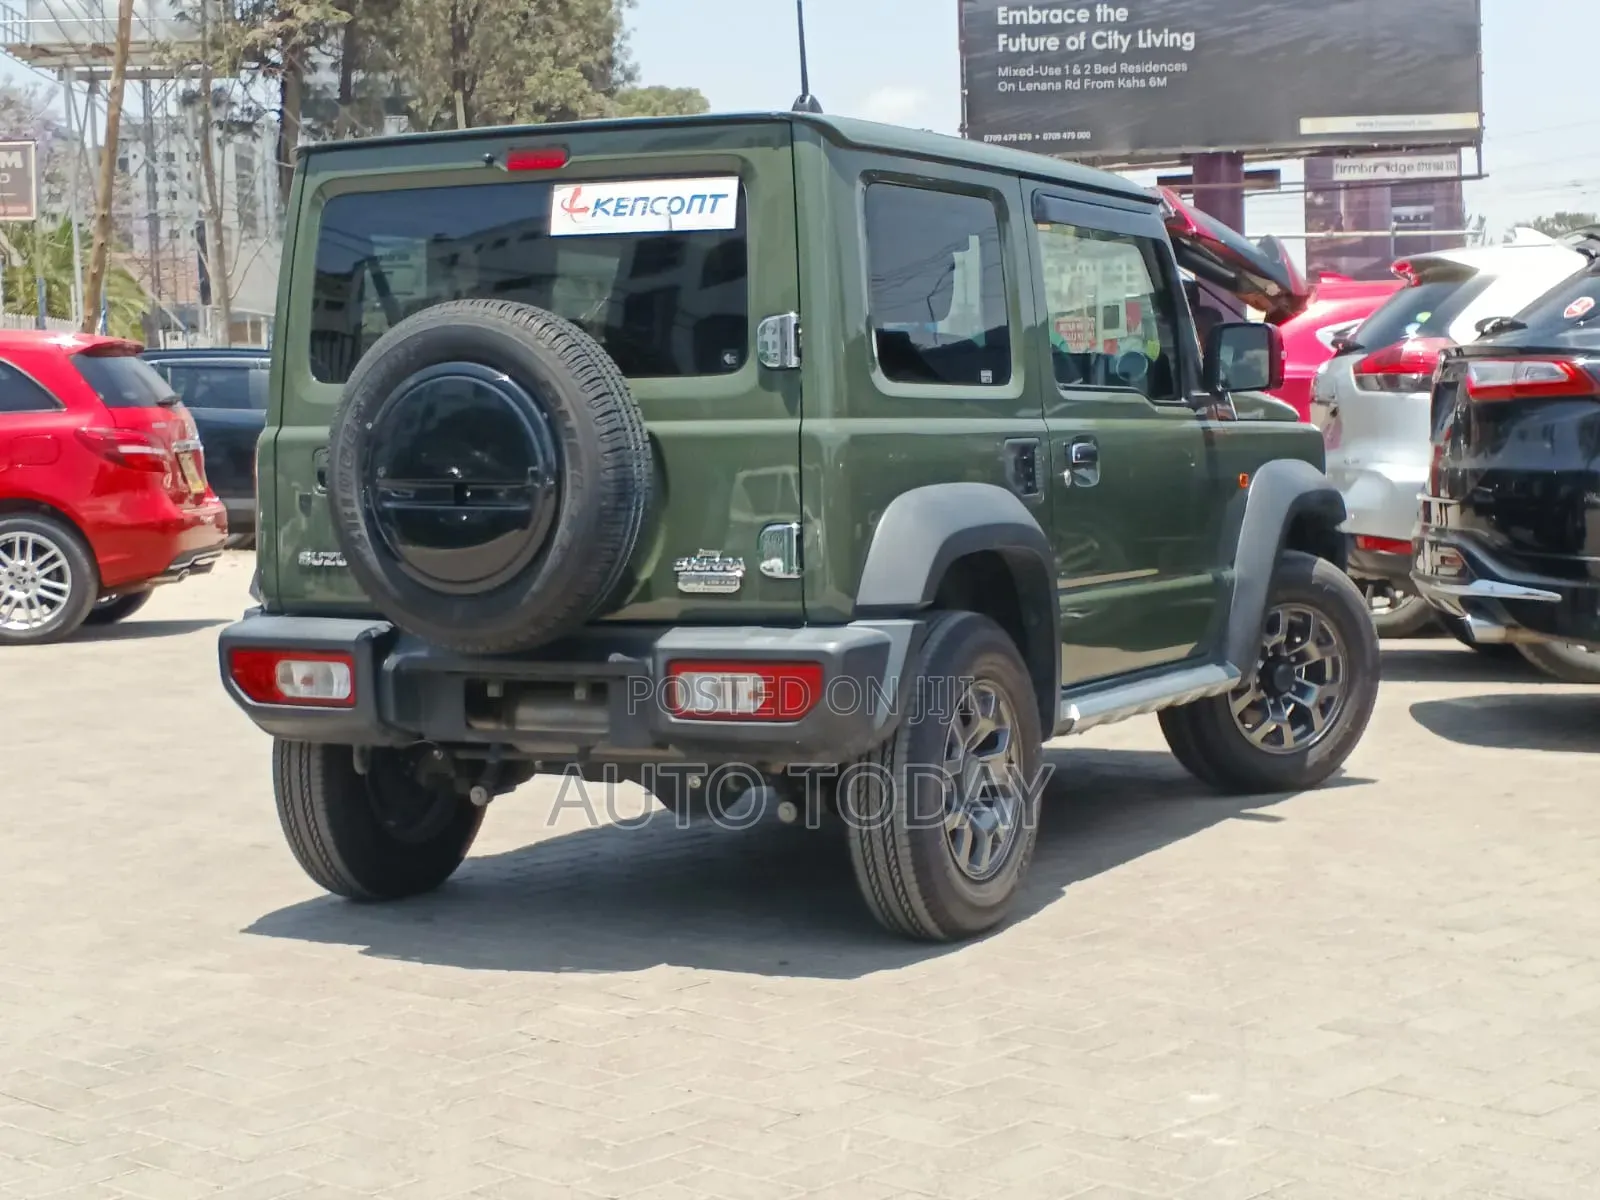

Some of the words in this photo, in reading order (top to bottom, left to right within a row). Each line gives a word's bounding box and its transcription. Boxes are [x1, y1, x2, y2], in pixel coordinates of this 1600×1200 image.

[997, 6, 1090, 25] Embrace
[1096, 4, 1129, 23] the
[998, 33, 1060, 52] Future
[1066, 31, 1086, 50] of
[1092, 31, 1131, 54] City
[1138, 28, 1196, 51] Living
[997, 65, 1062, 77] Mixed-Use
[1072, 64, 1082, 75] &
[1084, 64, 1091, 75] 2
[1094, 62, 1117, 74] Bed
[1120, 61, 1188, 73] Residences
[998, 81, 1016, 92] On
[1065, 78, 1081, 90] Rd
[1084, 78, 1115, 89] From
